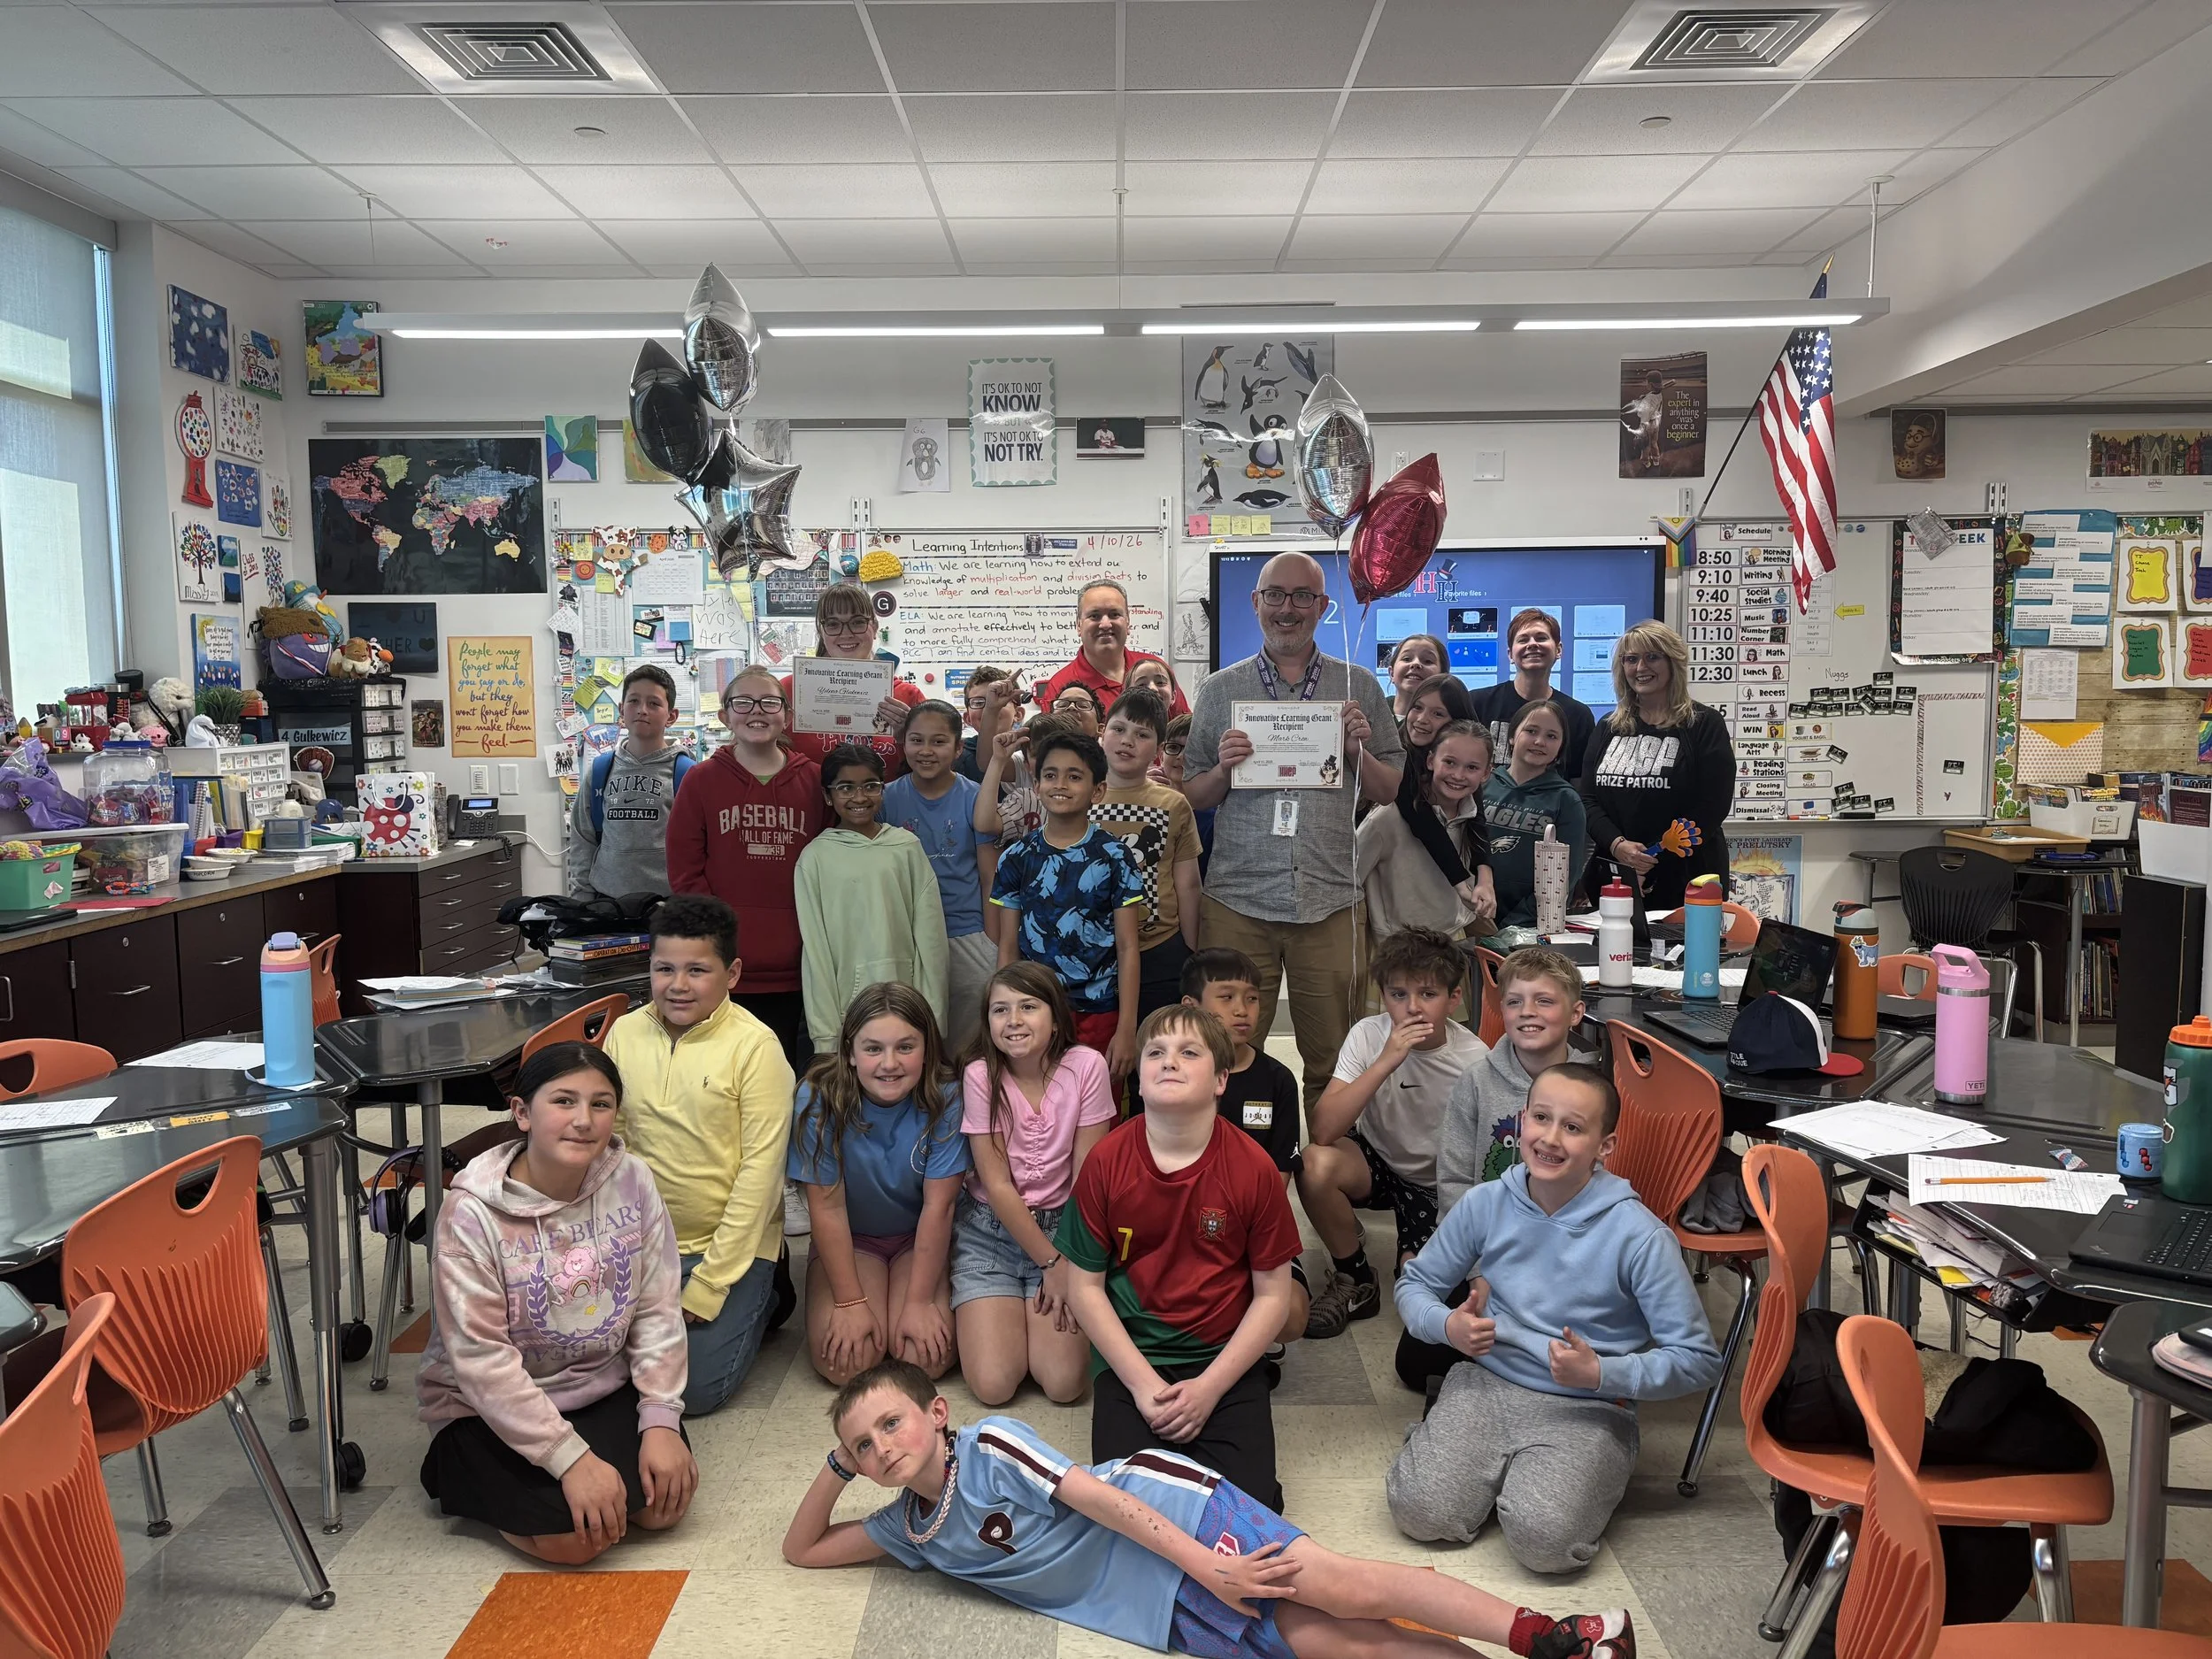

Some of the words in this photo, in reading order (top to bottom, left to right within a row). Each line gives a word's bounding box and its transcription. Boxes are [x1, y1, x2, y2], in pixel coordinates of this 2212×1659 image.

[982, 383, 995, 394] IT'S
[998, 383, 1010, 393] OK
[1010, 383, 1023, 393] TO
[1025, 382, 1042, 393] NOT
[1676, 391, 1690, 400] The
[982, 395, 1041, 413] KNOW,
[1668, 400, 1691, 409] expert
[1670, 408, 1699, 419] anything
[1005, 418, 1021, 426] BUT
[984, 432, 997, 442] IT'S
[1000, 432, 1017, 442] NOT
[1019, 432, 1032, 442] OK
[1033, 431, 1044, 442] TO
[984, 444, 1014, 462] NOT
[1018, 443, 1044, 462] TRY.
[1959, 533, 1985, 544] EEK
[912, 539, 966, 554] Learning
[970, 540, 1024, 552] Intentions
[1699, 550, 1732, 565] 8:50
[939, 561, 958, 571] We
[986, 559, 1026, 574] learning
[1030, 558, 1053, 568] how
[1069, 557, 1102, 568] extend
[902, 575, 953, 589] knowledge
[956, 575, 966, 584] of
[970, 572, 1037, 586] multiplication
[1043, 574, 1062, 583] and
[1067, 572, 1101, 580] division
[1138, 571, 1148, 580] to
[1698, 570, 1732, 584] 9:10
[903, 588, 929, 598] solve
[935, 588, 963, 600] larger
[971, 587, 989, 595] and
[995, 586, 1042, 596] real-world
[1696, 589, 1729, 603] 9:40
[1747, 588, 1770, 596] Social
[878, 597, 889, 611] G
[1745, 596, 1771, 605] Studies
[929, 611, 945, 621] We
[968, 611, 1008, 625] learning
[1323, 599, 1340, 625] 2
[1691, 607, 1732, 622] 10:25
[904, 625, 926, 635] and
[933, 623, 980, 634] annotate
[984, 621, 1035, 634] effectively
[1041, 621, 1053, 631] to
[1141, 621, 1159, 631] and
[1692, 626, 1732, 641] 11:10
[952, 635, 973, 648] fully
[979, 634, 1037, 644] comprehend
[1041, 635, 1069, 644] what
[459, 641, 493, 661] People
[495, 649, 521, 662] may
[957, 648, 975, 657] find
[979, 648, 1014, 657] central
[1018, 648, 1040, 657] ideas
[1042, 648, 1060, 657] and
[1692, 646, 1734, 661] 11:30
[461, 658, 492, 679] forget
[495, 657, 520, 671] what
[804, 667, 835, 677] Innovative
[836, 670, 863, 680] Learning
[1690, 666, 1732, 681] 12:30
[458, 678, 476, 692] you
[479, 678, 495, 690] say
[511, 672, 526, 688] do,
[830, 677, 856, 686] Recipient
[470, 690, 487, 703] but
[490, 687, 513, 706] they
[455, 708, 478, 717] won't
[480, 704, 508, 724] forget
[511, 702, 529, 716] how
[1245, 713, 1279, 723] Innovative
[1281, 713, 1310, 724] Learning
[1311, 713, 1333, 722] Grant
[455, 726, 472, 738] you
[474, 719, 503, 732] make
[506, 717, 532, 731] them
[1272, 723, 1304, 733] Recipient
[281, 731, 290, 741] 4
[294, 729, 347, 743] Gulkewicz
[481, 733, 508, 754] feel.
[1738, 741, 1770, 750] Language
[607, 775, 663, 797] NIKE
[1596, 775, 1624, 787] PRIZE
[1626, 777, 1671, 789] PATROL
[718, 803, 807, 837] BASEBALL
[1484, 805, 1553, 833] AGLES
[763, 832, 772, 844] OF
[773, 832, 795, 844] FAME
[1609, 952, 1632, 962] veriz
[1118, 1226, 1133, 1262] 7
